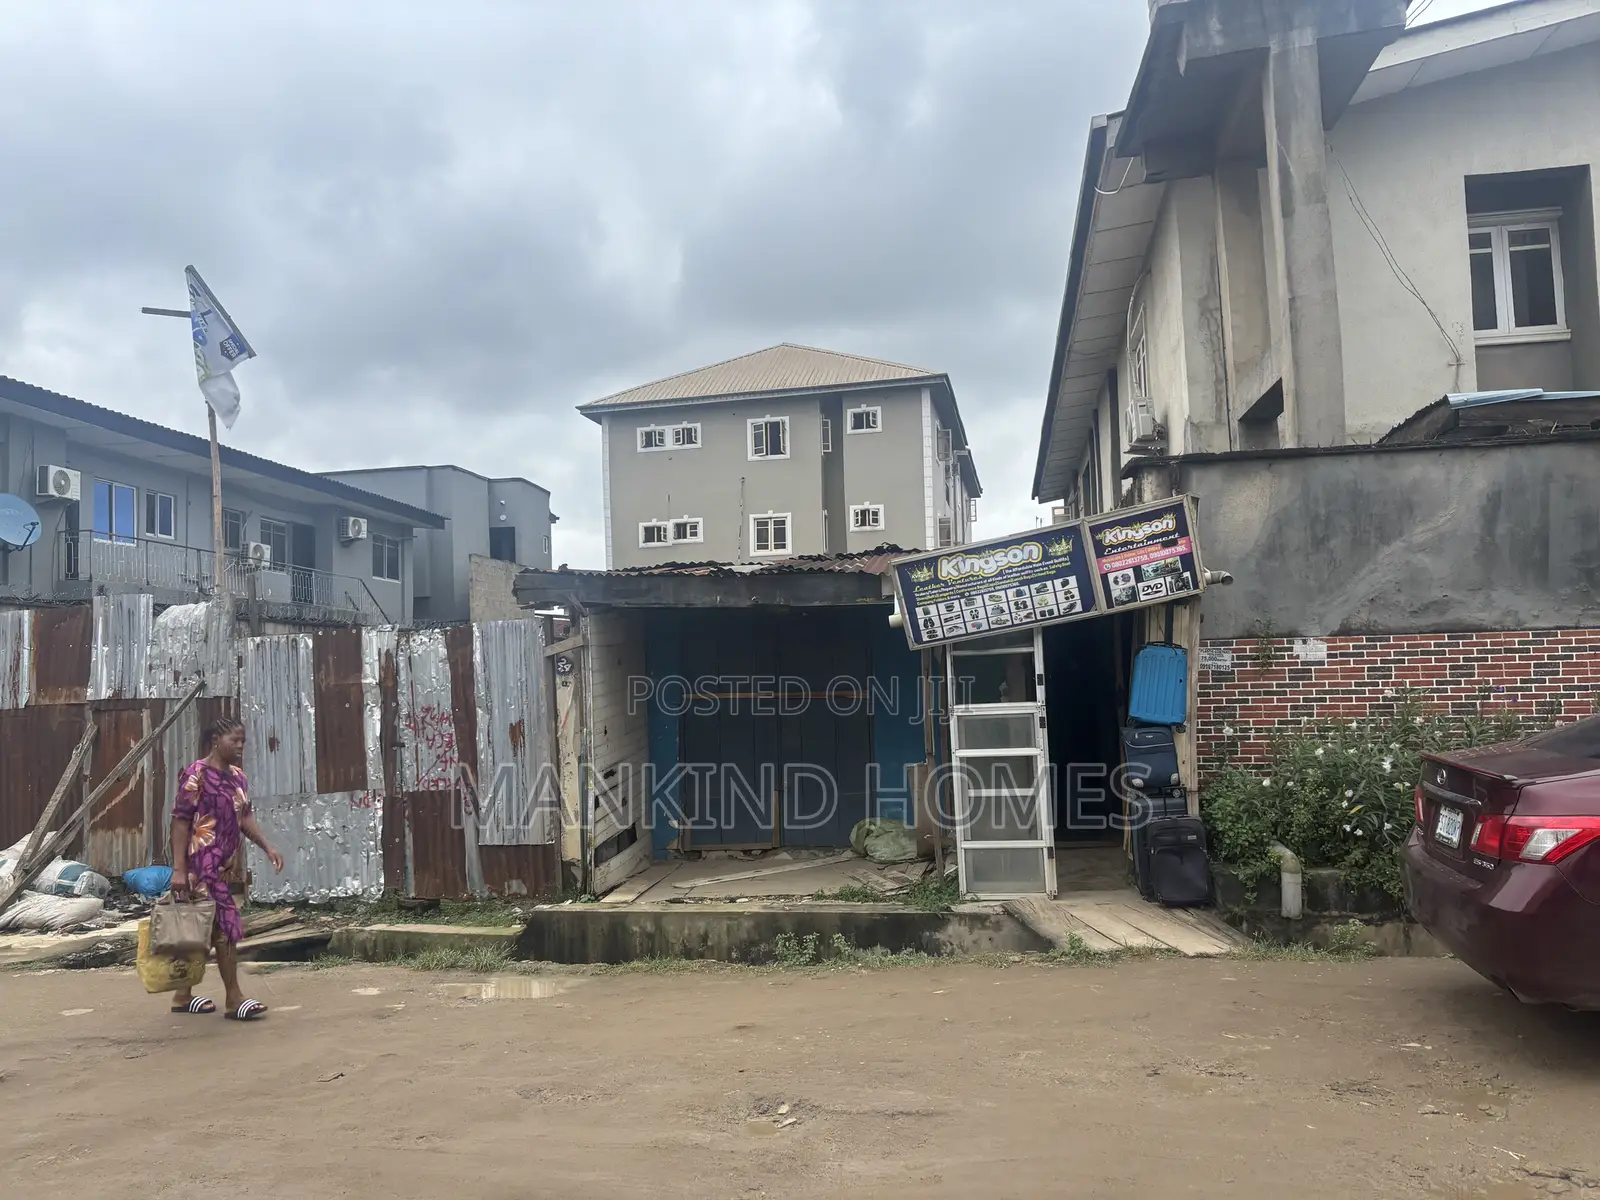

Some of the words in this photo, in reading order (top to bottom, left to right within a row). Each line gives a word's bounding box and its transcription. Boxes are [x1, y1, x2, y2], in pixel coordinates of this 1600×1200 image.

[223, 340, 237, 358] OFFER
[1104, 517, 1175, 544] Kingson
[1104, 532, 1180, 555] Entertainment
[939, 543, 1041, 579] Kingson
[913, 582, 945, 593] Leather
[948, 575, 982, 585] Ventures
[1142, 583, 1163, 592] DVD
